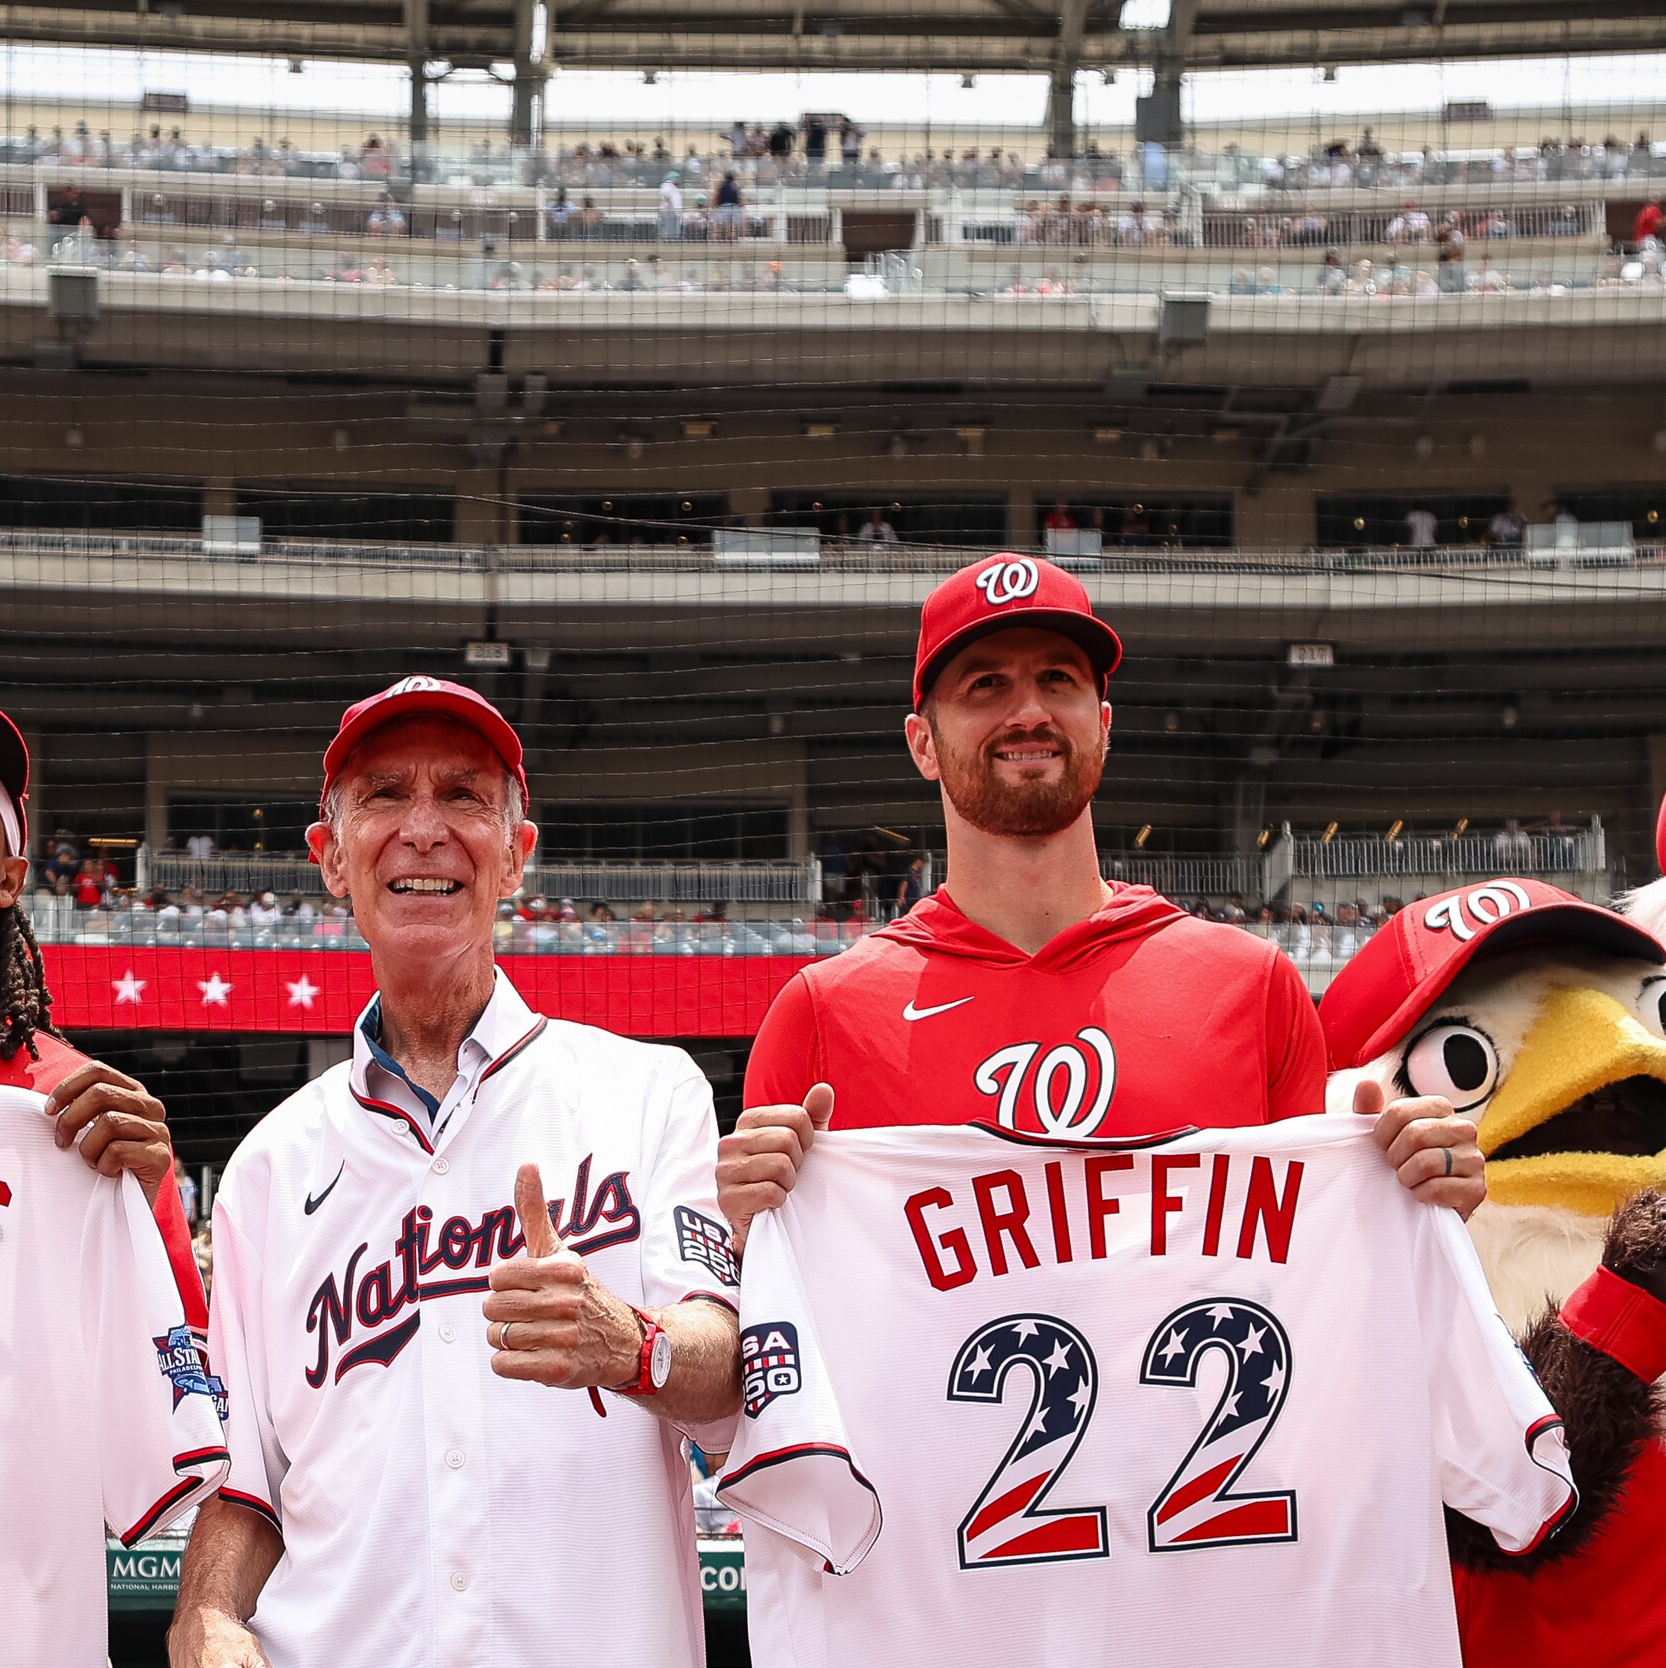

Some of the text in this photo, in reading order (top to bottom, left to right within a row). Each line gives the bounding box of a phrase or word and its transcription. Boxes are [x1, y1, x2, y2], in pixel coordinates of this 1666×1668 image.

[904, 1153, 1306, 1292] GRIFFIN
[742, 1330, 792, 1358] SA
[743, 1367, 800, 1400] 50
[946, 1296, 1300, 1571] 22
[112, 1556, 181, 1578] MGM
[700, 1566, 747, 1592] co
[110, 1583, 180, 1591] NATIONAL HARBO
